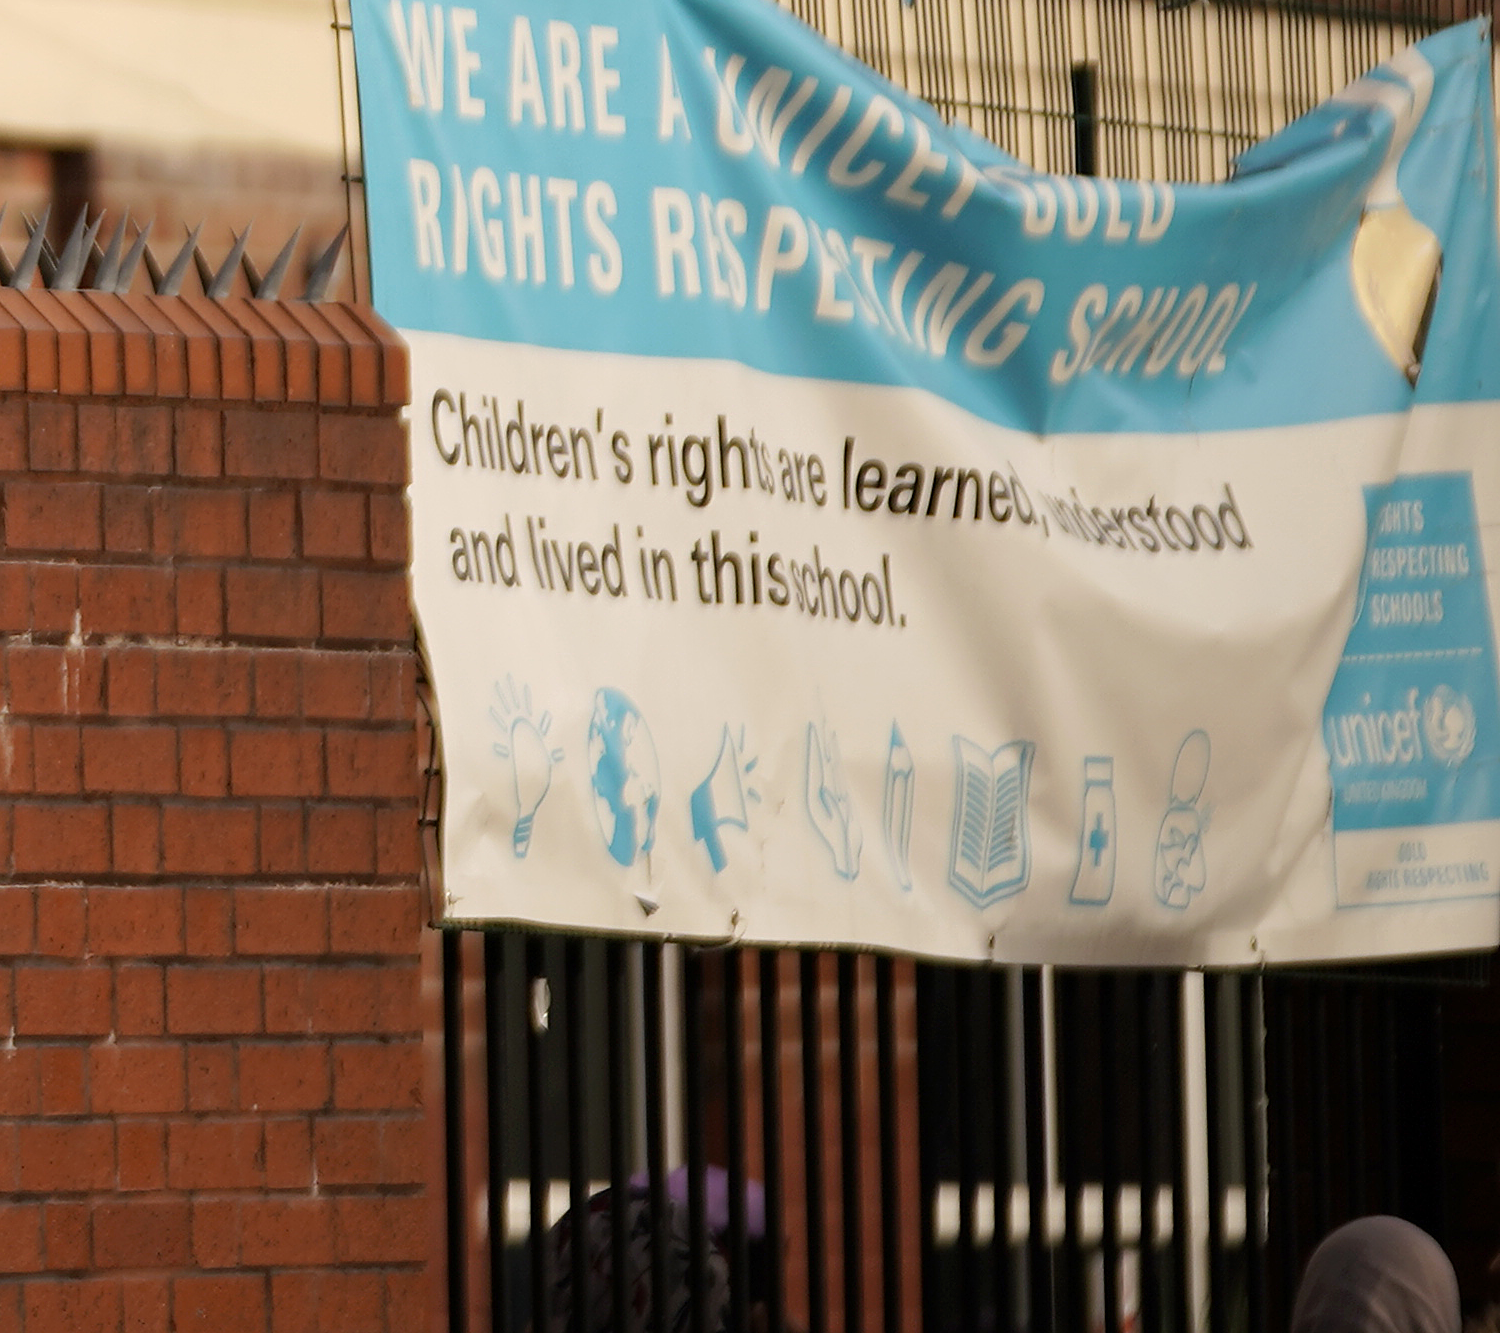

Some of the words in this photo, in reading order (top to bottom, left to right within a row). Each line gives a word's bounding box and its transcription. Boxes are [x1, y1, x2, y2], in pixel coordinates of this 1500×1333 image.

[510, 15, 627, 135] ARE
[658, 32, 693, 142] A
[408, 157, 624, 294] RIGHTS
[1049, 280, 1258, 385] SCHOOL
[431, 387, 635, 485] Children's
[648, 413, 776, 507] rights
[777, 446, 829, 507] are
[841, 435, 1050, 539] learned,
[1040, 482, 1254, 553] understood
[450, 513, 521, 588] and
[527, 514, 628, 598] lived
[637, 525, 679, 602] in
[690, 529, 792, 607] this
[791, 544, 907, 627] school.
[1371, 542, 1470, 579] RESPECTING
[1371, 589, 1444, 625] SCHOOLS
[1329, 686, 1424, 766] unicef
